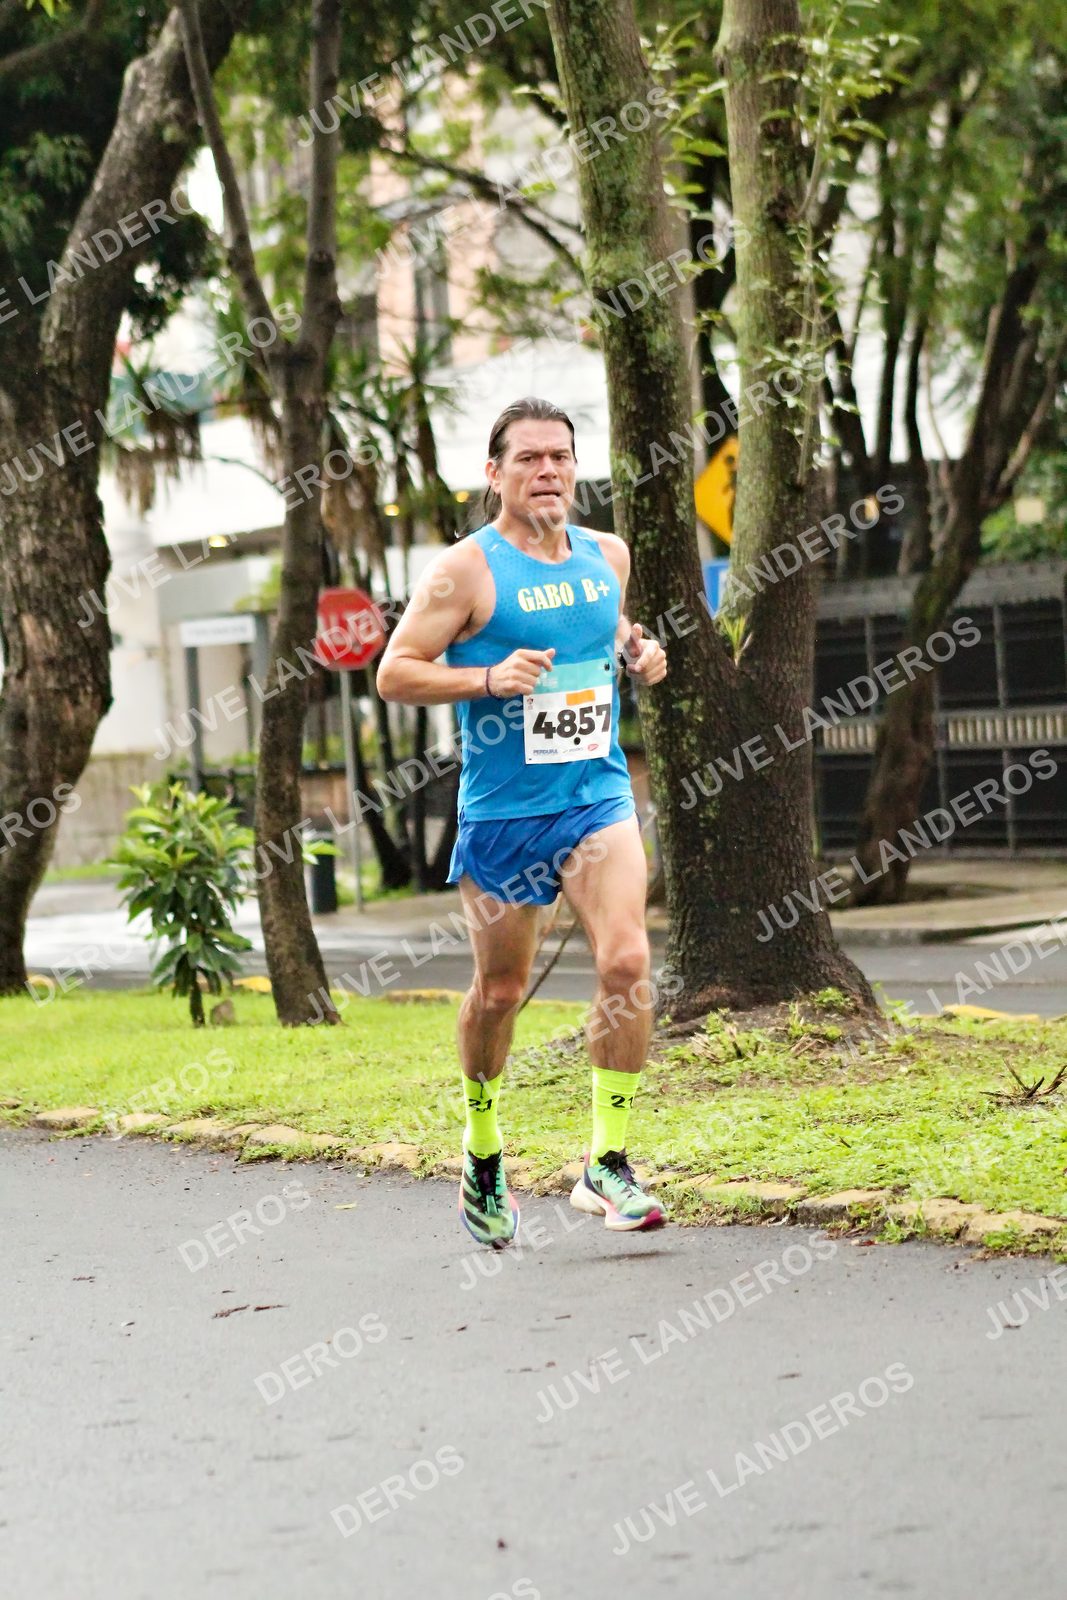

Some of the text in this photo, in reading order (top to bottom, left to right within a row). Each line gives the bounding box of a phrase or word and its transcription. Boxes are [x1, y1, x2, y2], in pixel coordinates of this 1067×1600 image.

[518, 578, 610, 613] GABO B+
[532, 703, 611, 739] 4857
